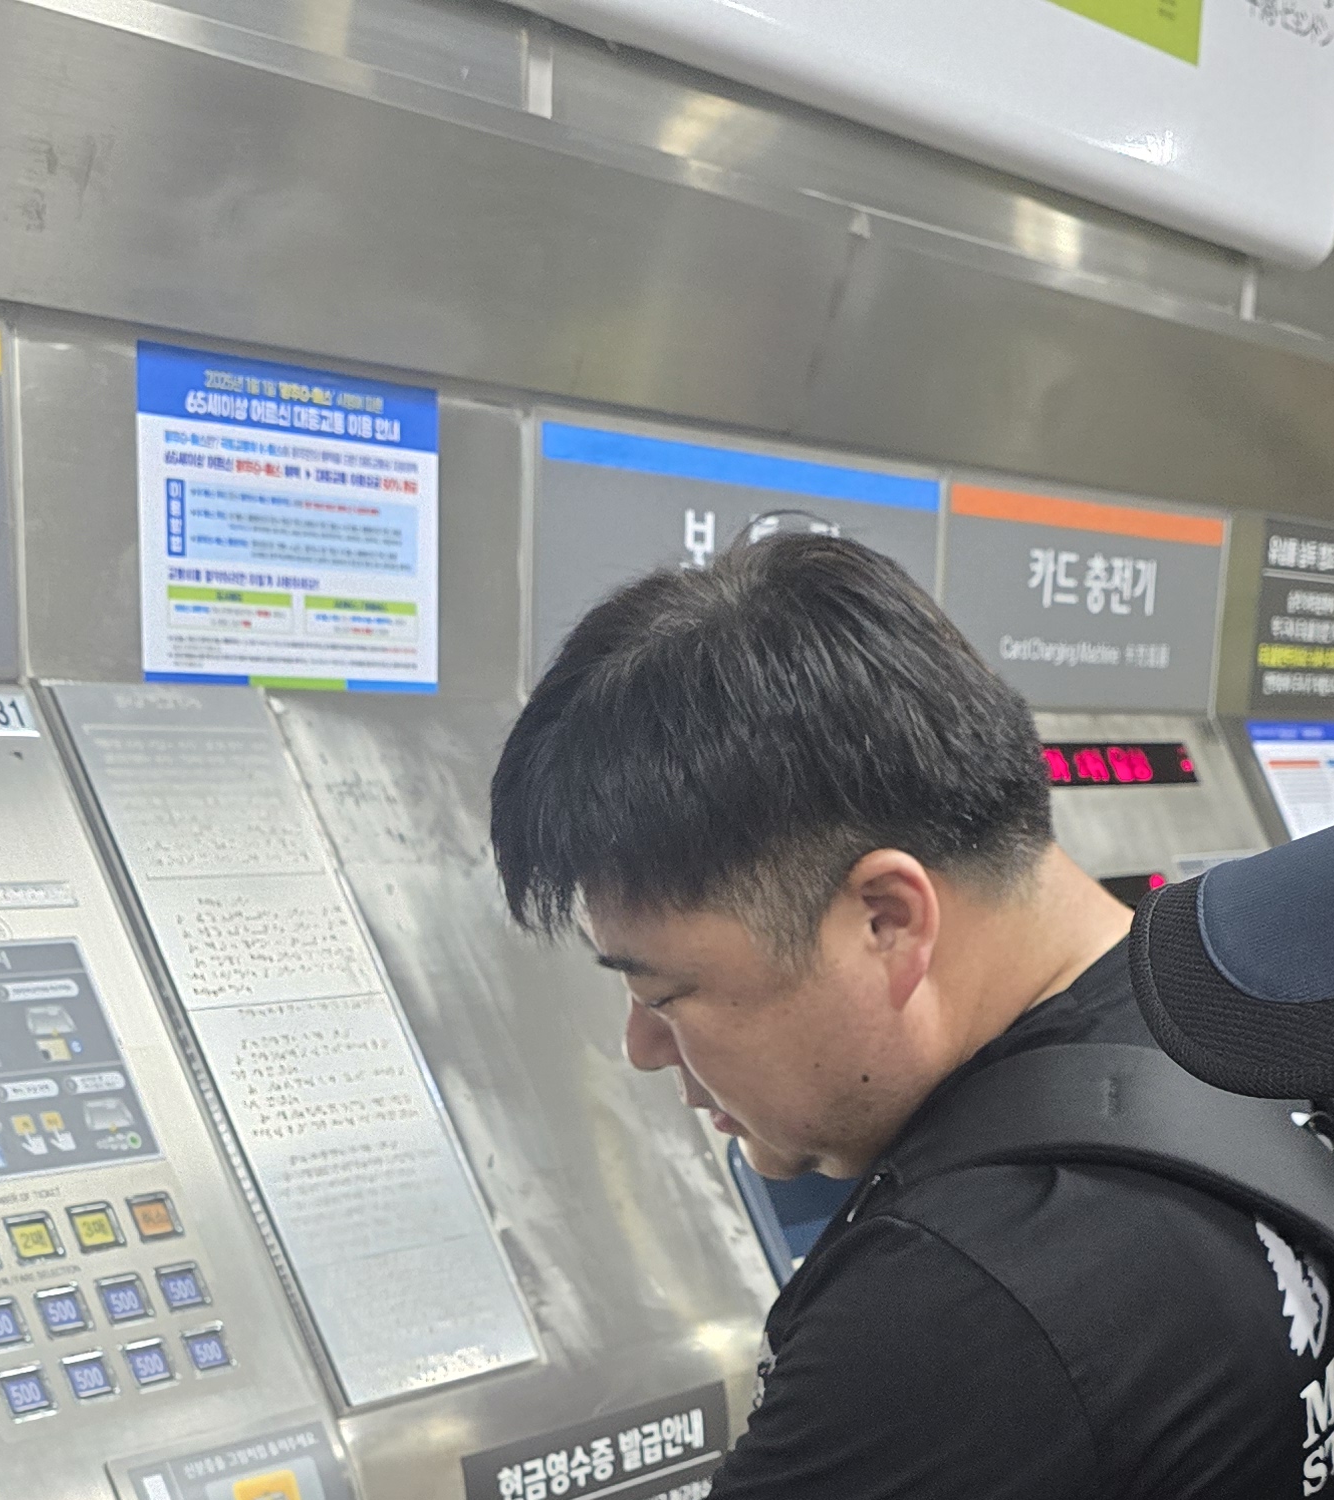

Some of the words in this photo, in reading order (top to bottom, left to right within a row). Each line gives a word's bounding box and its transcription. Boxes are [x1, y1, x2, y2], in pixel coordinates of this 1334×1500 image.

[184, 388, 248, 422] 65세이상
[1027, 548, 1080, 609] 카드
[1083, 551, 1159, 617] 충전기
[168, 1278, 197, 1301] 500
[47, 1298, 78, 1323] 500
[110, 1290, 139, 1314] 500
[194, 1340, 223, 1364] 500
[135, 1353, 165, 1376] 500
[75, 1366, 105, 1390] 500
[10, 1381, 42, 1406] 500
[617, 1407, 706, 1473] 발급안내
